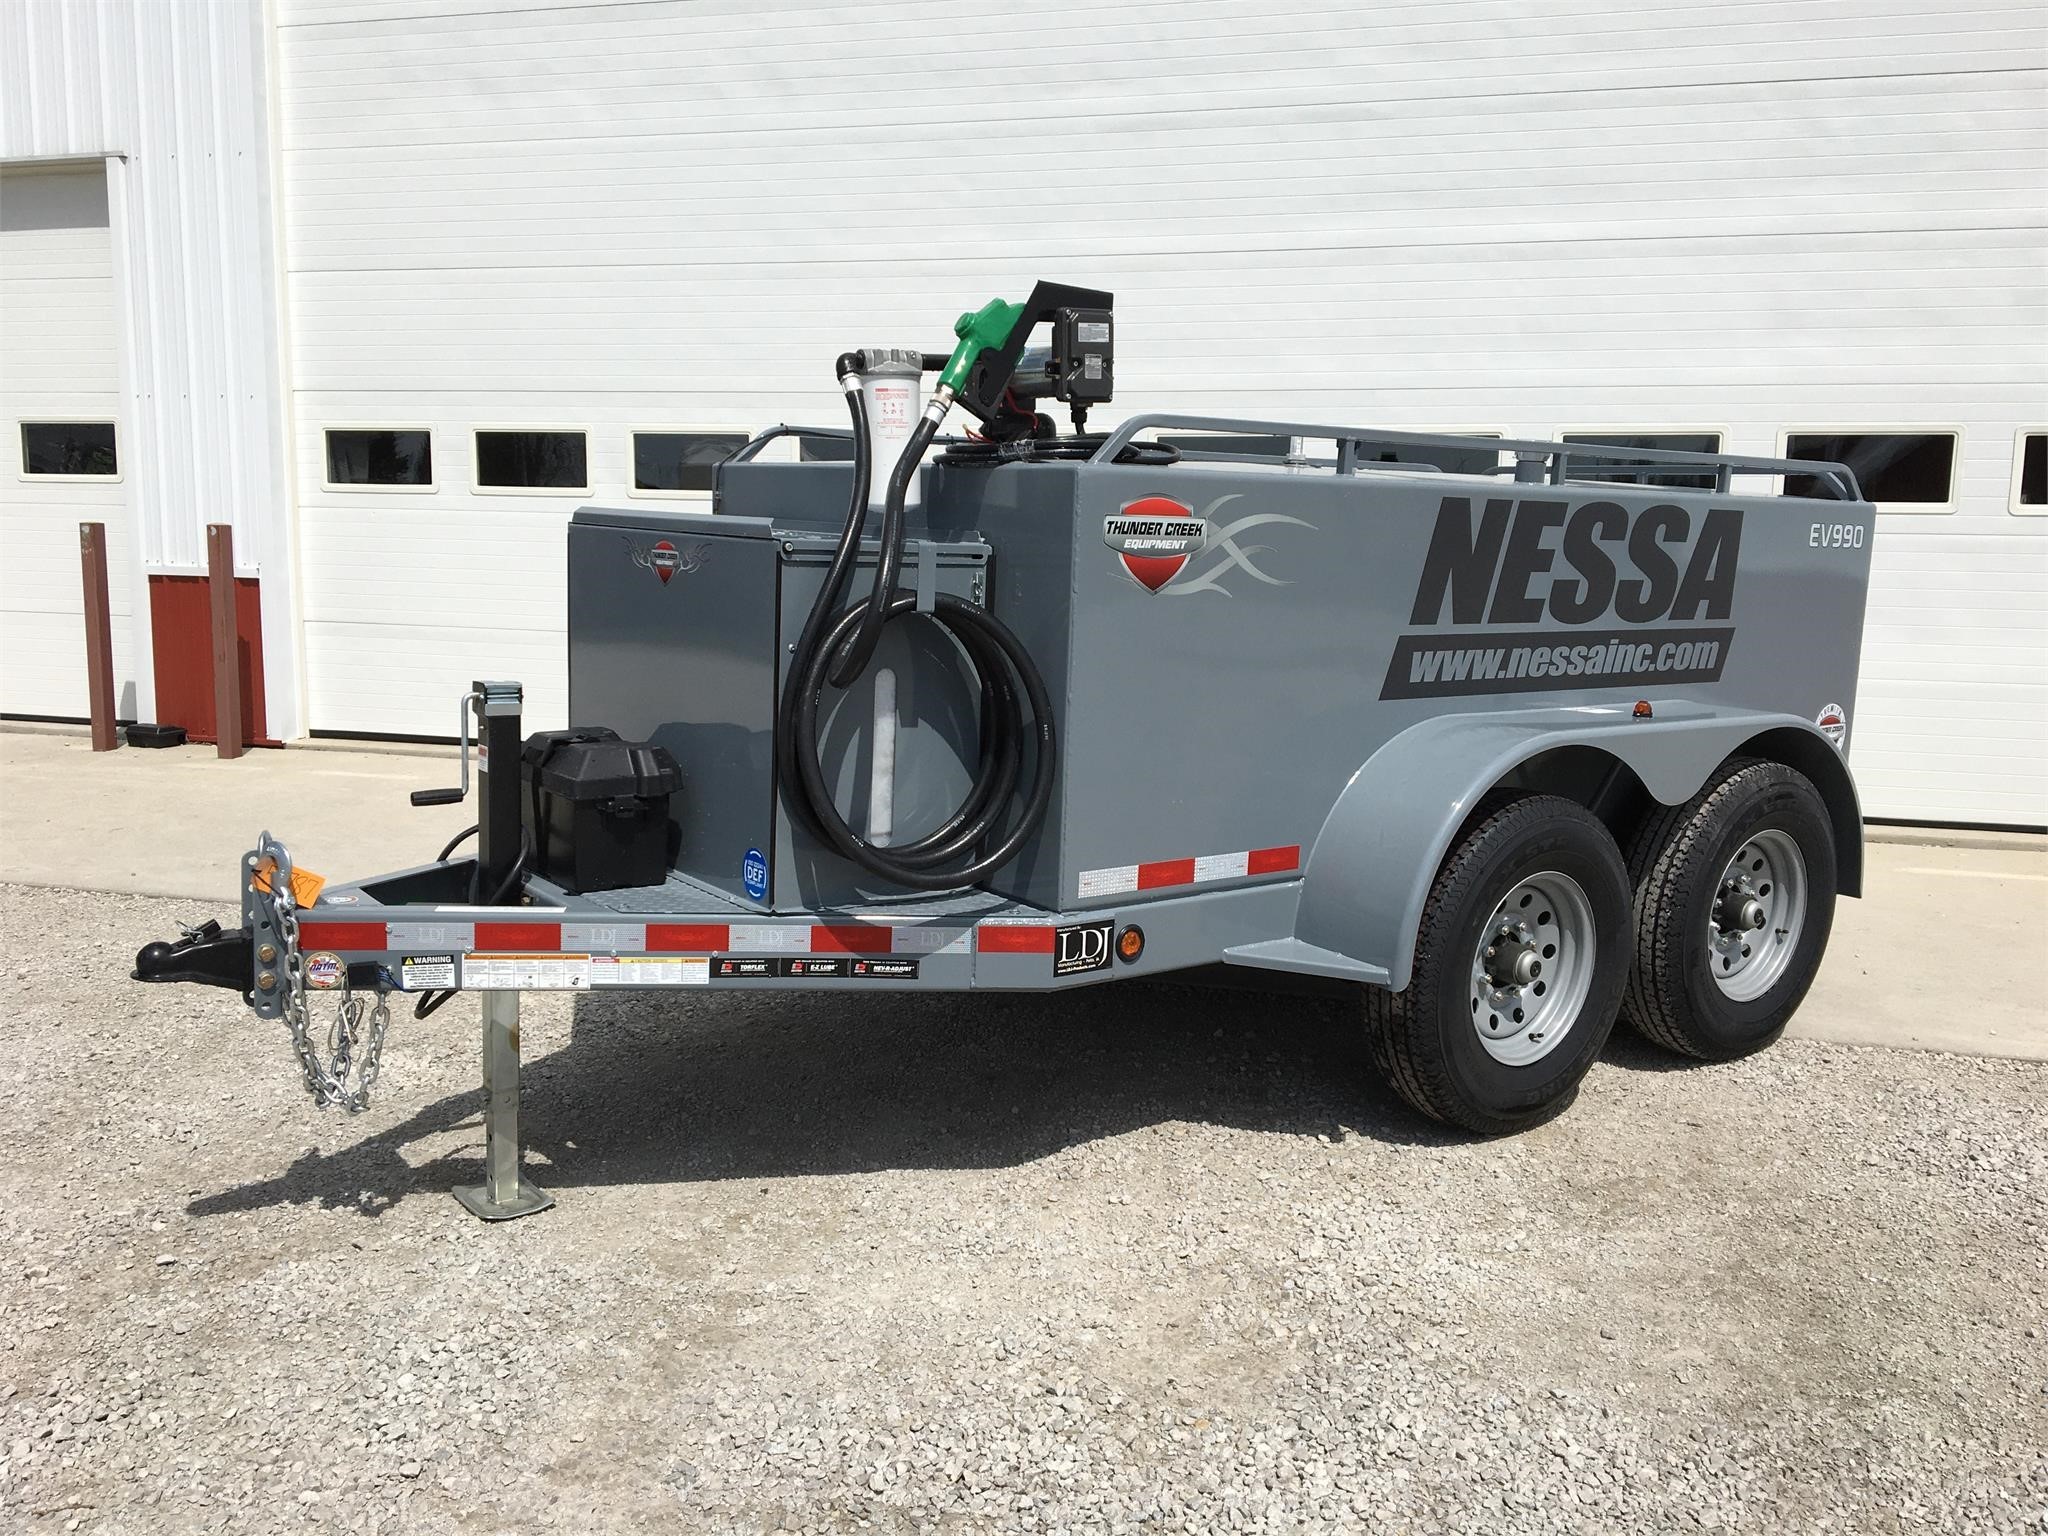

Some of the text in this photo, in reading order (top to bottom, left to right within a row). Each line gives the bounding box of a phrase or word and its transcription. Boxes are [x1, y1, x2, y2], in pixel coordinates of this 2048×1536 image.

[1106, 521, 1204, 537] THUNDER CREEK
[1808, 523, 1865, 549] EV990
[1124, 539, 1188, 549] EQUIPMENT
[1408, 496, 1743, 625] NESSA
[1409, 639, 1720, 683] www.nessainc.com
[747, 866, 763, 882] DEF
[1059, 927, 1112, 966] LDJ
[413, 956, 452, 965] WARNING
